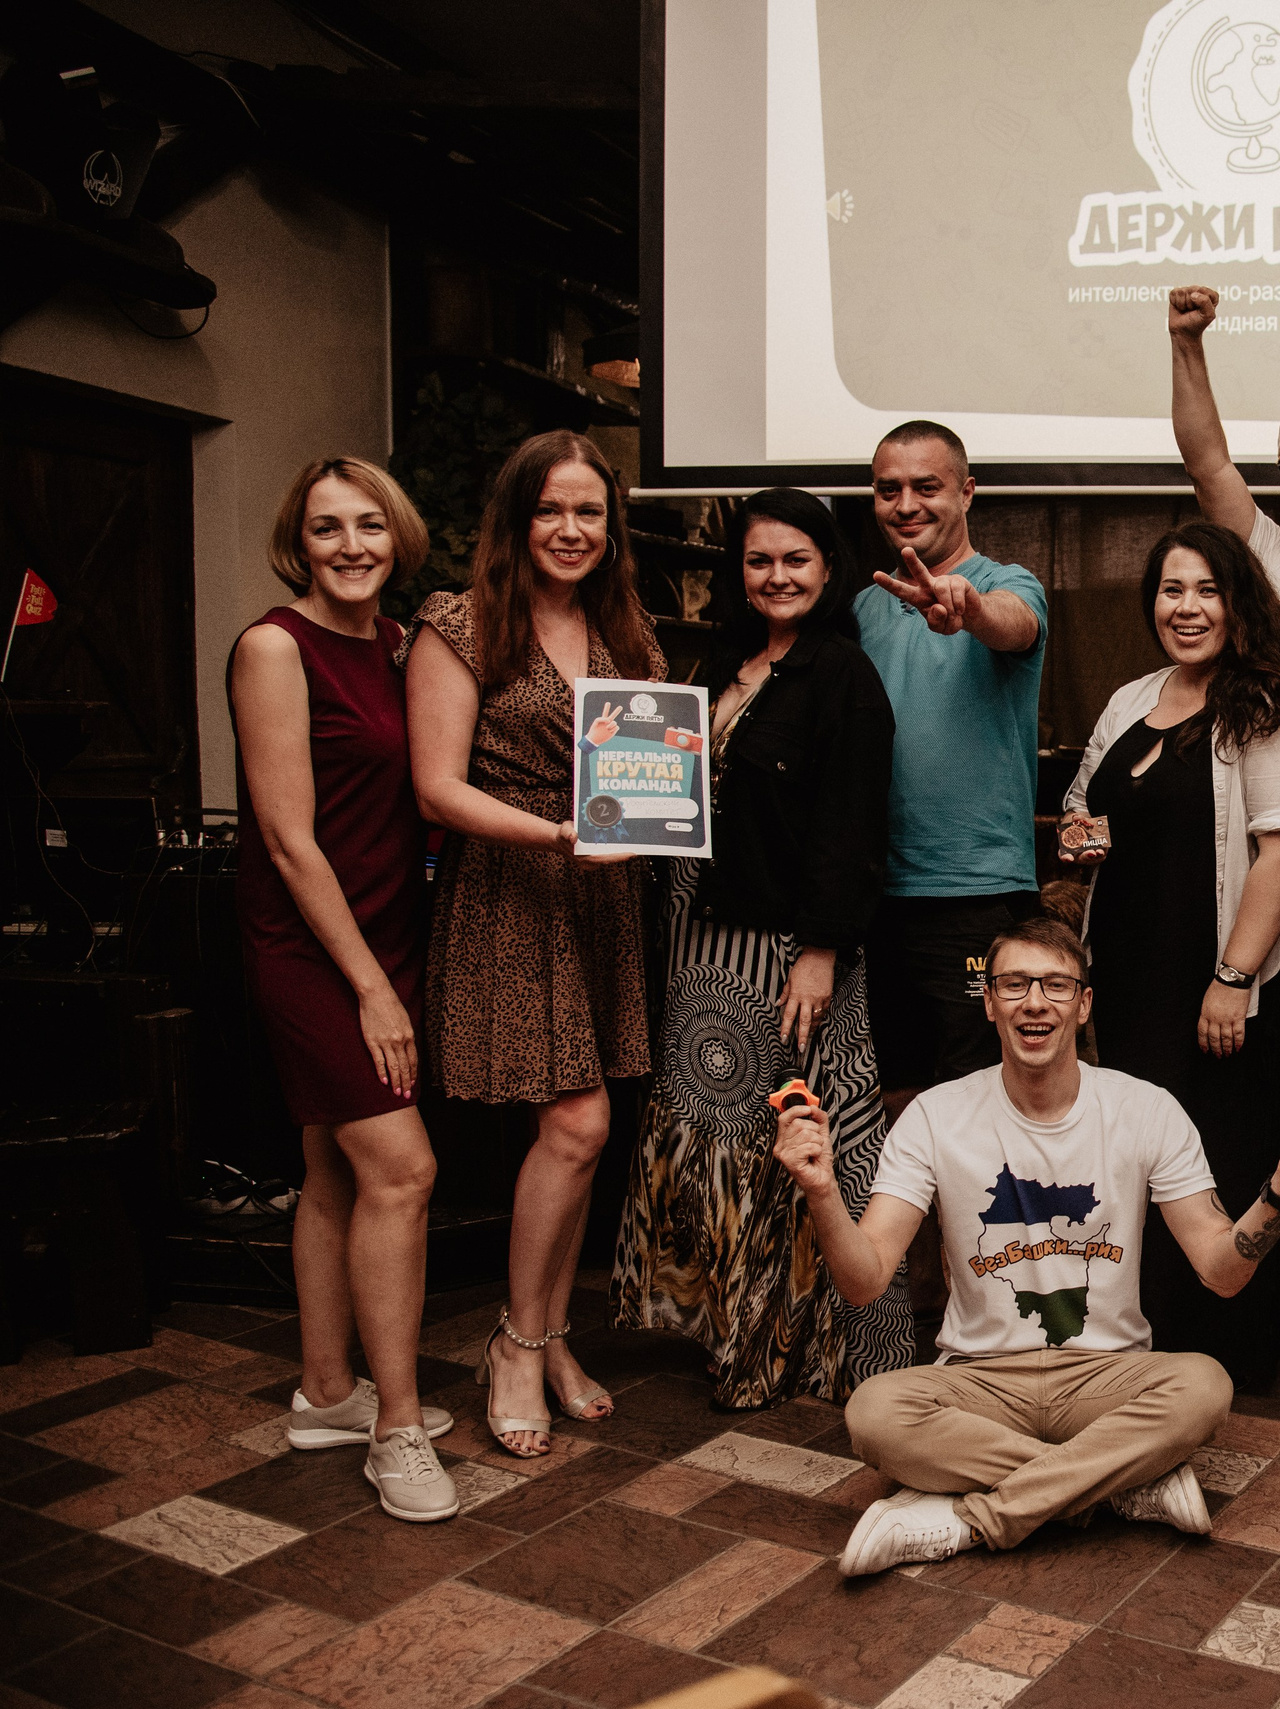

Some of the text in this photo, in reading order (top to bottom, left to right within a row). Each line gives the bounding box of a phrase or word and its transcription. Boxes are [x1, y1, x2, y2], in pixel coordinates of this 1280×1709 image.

[1079, 201, 1256, 255] ДЕРЖИ
[598, 750, 682, 764] НЕРЕАЛЬНО
[596, 761, 684, 781] КРУТАЯ
[598, 778, 683, 794] КОМАНДА
[598, 803, 610, 817] 2
[1082, 837, 1108, 848] ПИЦЦА
